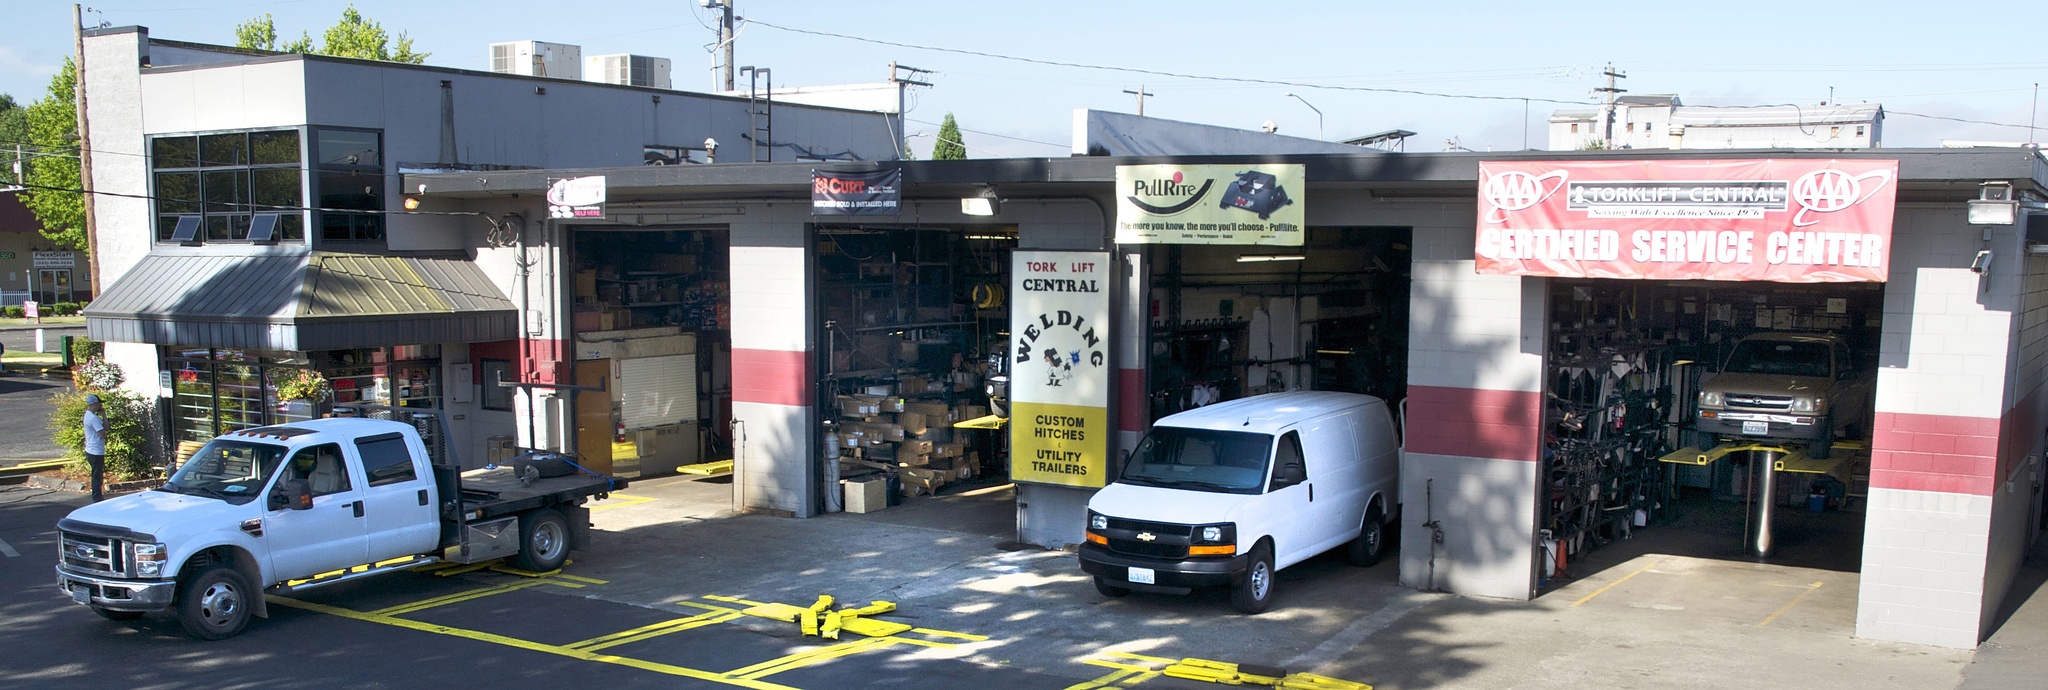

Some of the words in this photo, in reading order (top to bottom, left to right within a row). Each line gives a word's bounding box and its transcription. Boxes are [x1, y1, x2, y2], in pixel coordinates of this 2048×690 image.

[829, 177, 865, 194] CURT
[1488, 172, 1538, 209] AAA
[1799, 171, 1854, 211] AAA
[1589, 187, 1681, 202] TORKLIFT
[1689, 186, 1780, 202] CENTRAL
[837, 200, 850, 208] SOLD
[1120, 222, 1131, 230] The
[1133, 222, 1150, 230] more
[1151, 223, 1164, 231] you
[1166, 222, 1186, 231] know,
[1187, 222, 1198, 230] the
[1218, 222, 1236, 231] you'll
[1238, 223, 1264, 231] choose
[1481, 228, 1619, 261] CERTIFIED
[1632, 229, 1754, 264] SERVICE
[1766, 230, 1883, 268] CENTER
[1026, 262, 1057, 272] TORK
[1071, 262, 1095, 273] LIFT
[1023, 279, 1099, 293] CENTRAL
[1017, 310, 1103, 368] WELDING
[333, 378, 356, 389] OPEN
[1035, 415, 1085, 428] CUSTOM
[1034, 427, 1085, 441] HITCHES
[1037, 449, 1082, 462] UTILITY
[1032, 461, 1087, 475] TRAILERS
